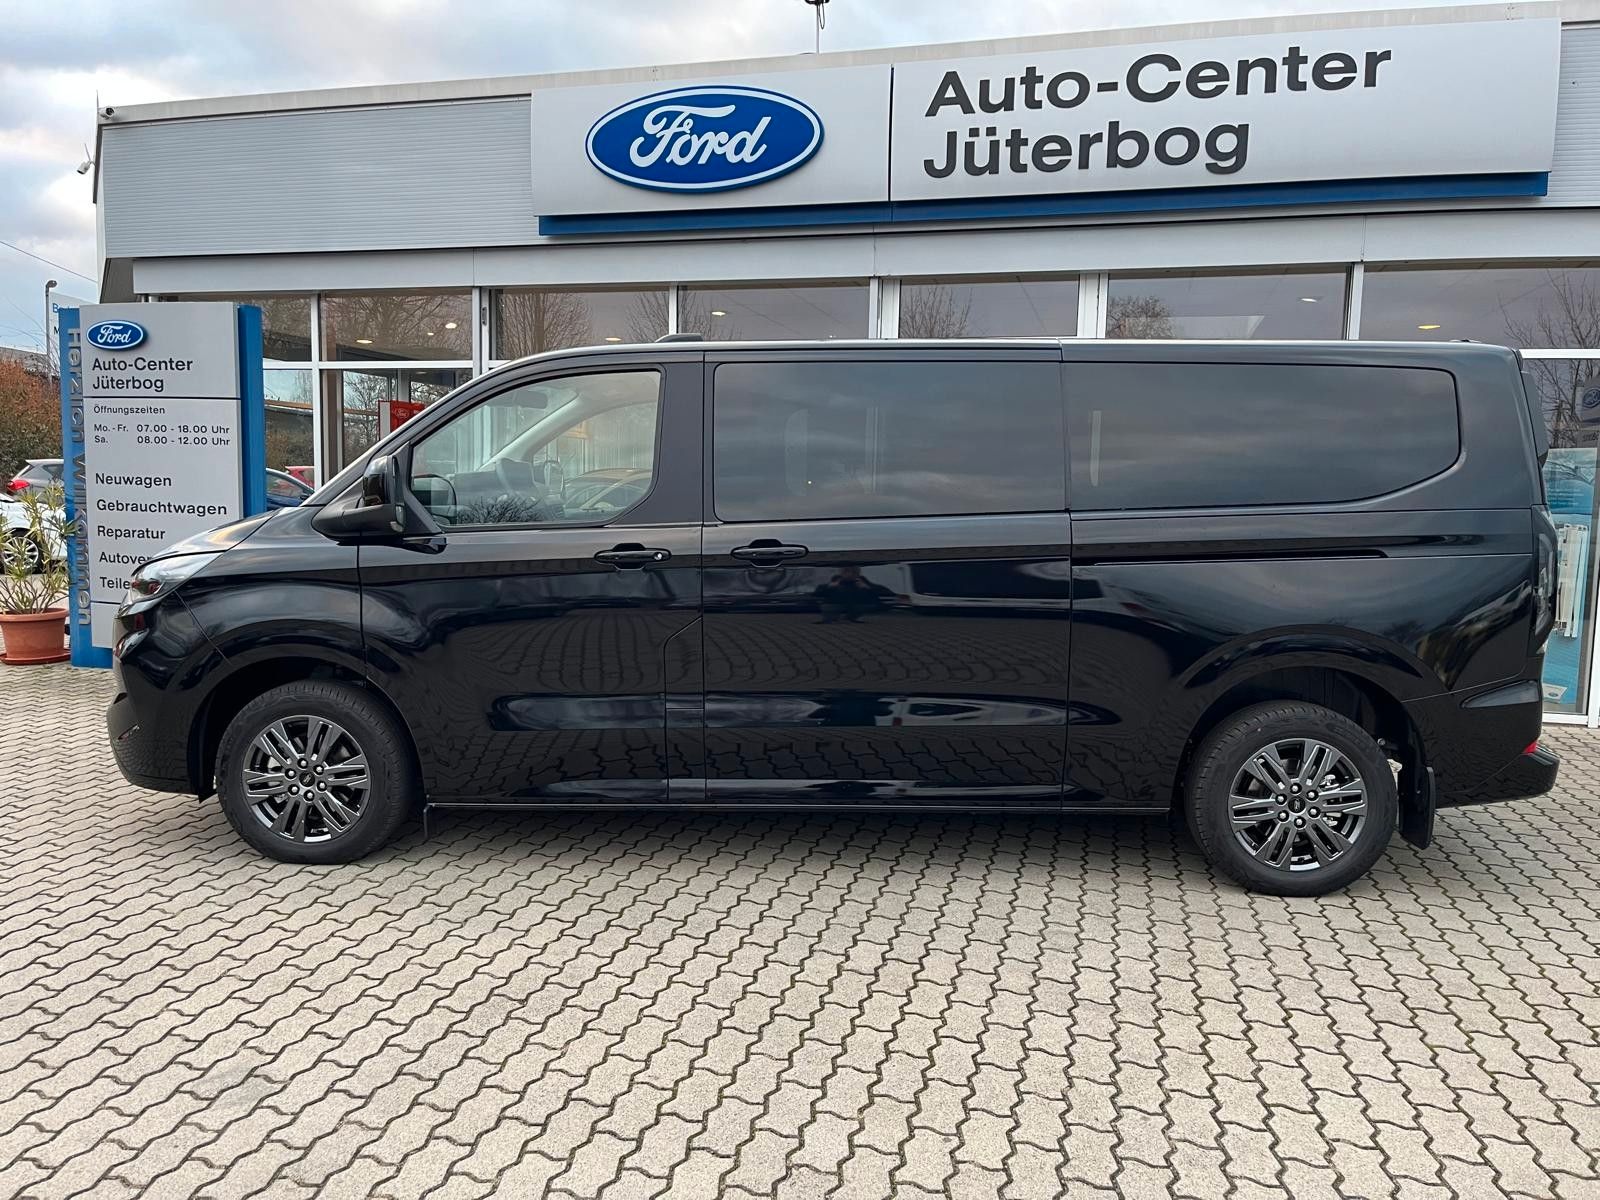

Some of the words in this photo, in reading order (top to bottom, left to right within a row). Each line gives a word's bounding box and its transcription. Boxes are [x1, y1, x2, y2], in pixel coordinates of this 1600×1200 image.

[924, 46, 1392, 117] Auto-Center
[629, 104, 772, 167] Ford
[923, 120, 1249, 179] Jüterbog
[97, 324, 132, 343] Ford
[92, 357, 193, 371] Auto-Center
[93, 376, 164, 392] Jüterbog
[93, 405, 166, 415] Öffnungszeiten
[136, 424, 167, 433] 07.00
[178, 425, 207, 434] 18.00
[211, 425, 230, 434] Uhr
[94, 435, 109, 443] Sa.
[137, 435, 168, 444] 08.00
[178, 436, 208, 445] 12.00
[211, 437, 231, 446] Uhr
[95, 473, 172, 488] Neuwagen
[96, 499, 227, 517] Gebrauchtwagen
[97, 525, 165, 540] Reparatur
[100, 576, 131, 589] Teile
